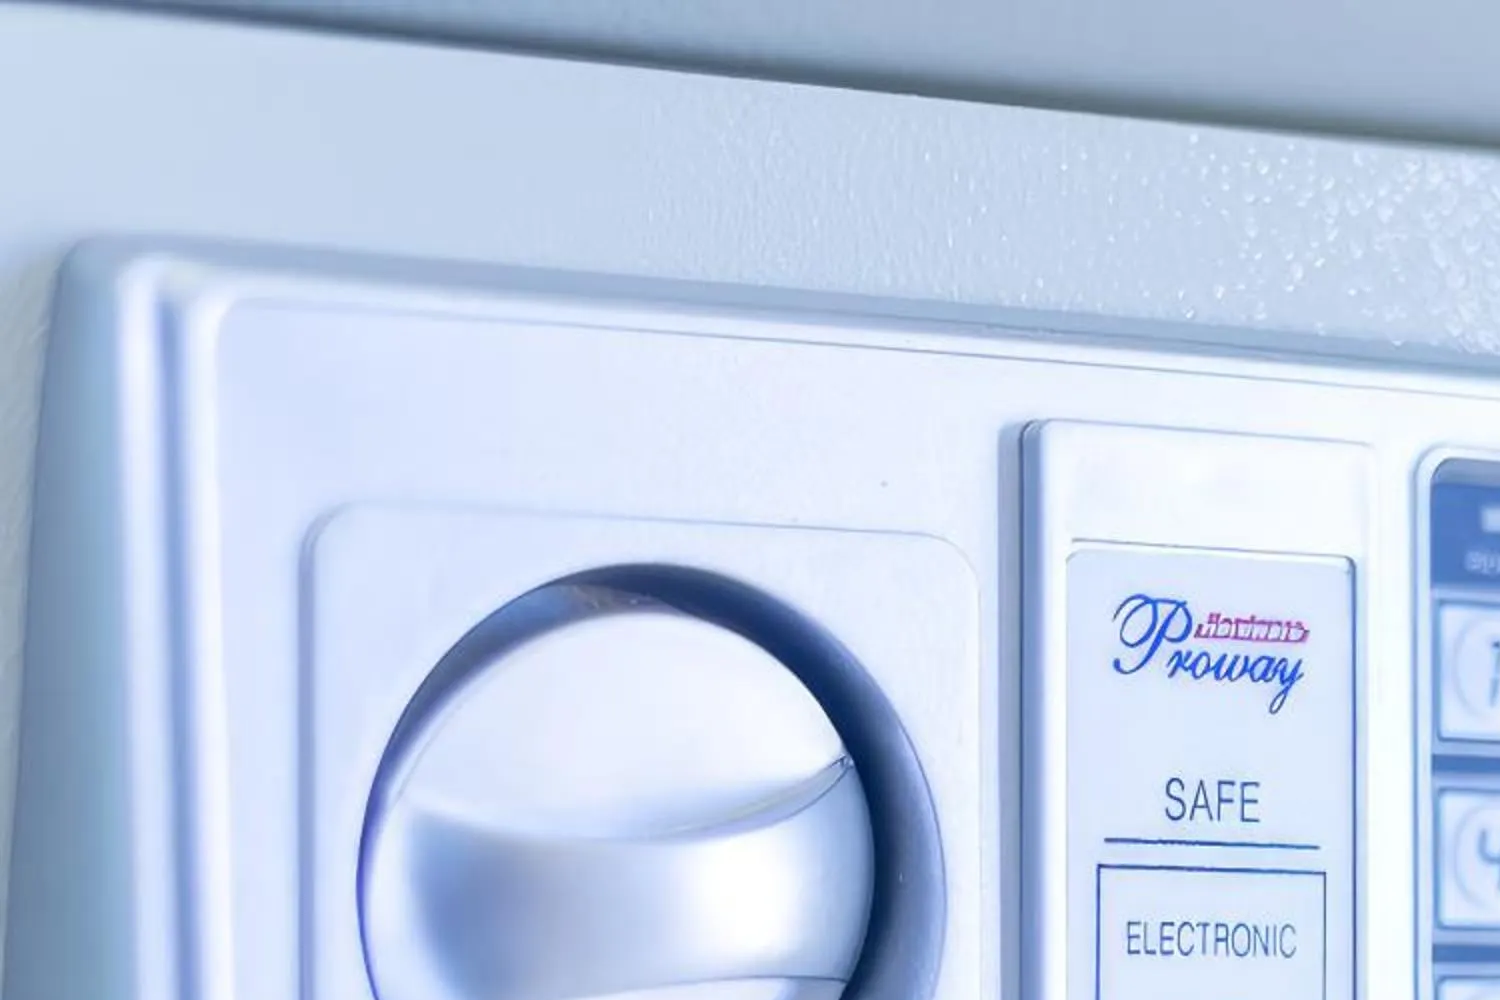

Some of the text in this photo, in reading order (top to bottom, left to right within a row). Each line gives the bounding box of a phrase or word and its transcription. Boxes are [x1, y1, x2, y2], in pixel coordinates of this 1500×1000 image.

[1111, 593, 1305, 714] Proway
[1164, 777, 1260, 823] SAFE
[1126, 920, 1297, 959] ELECTRONIC
